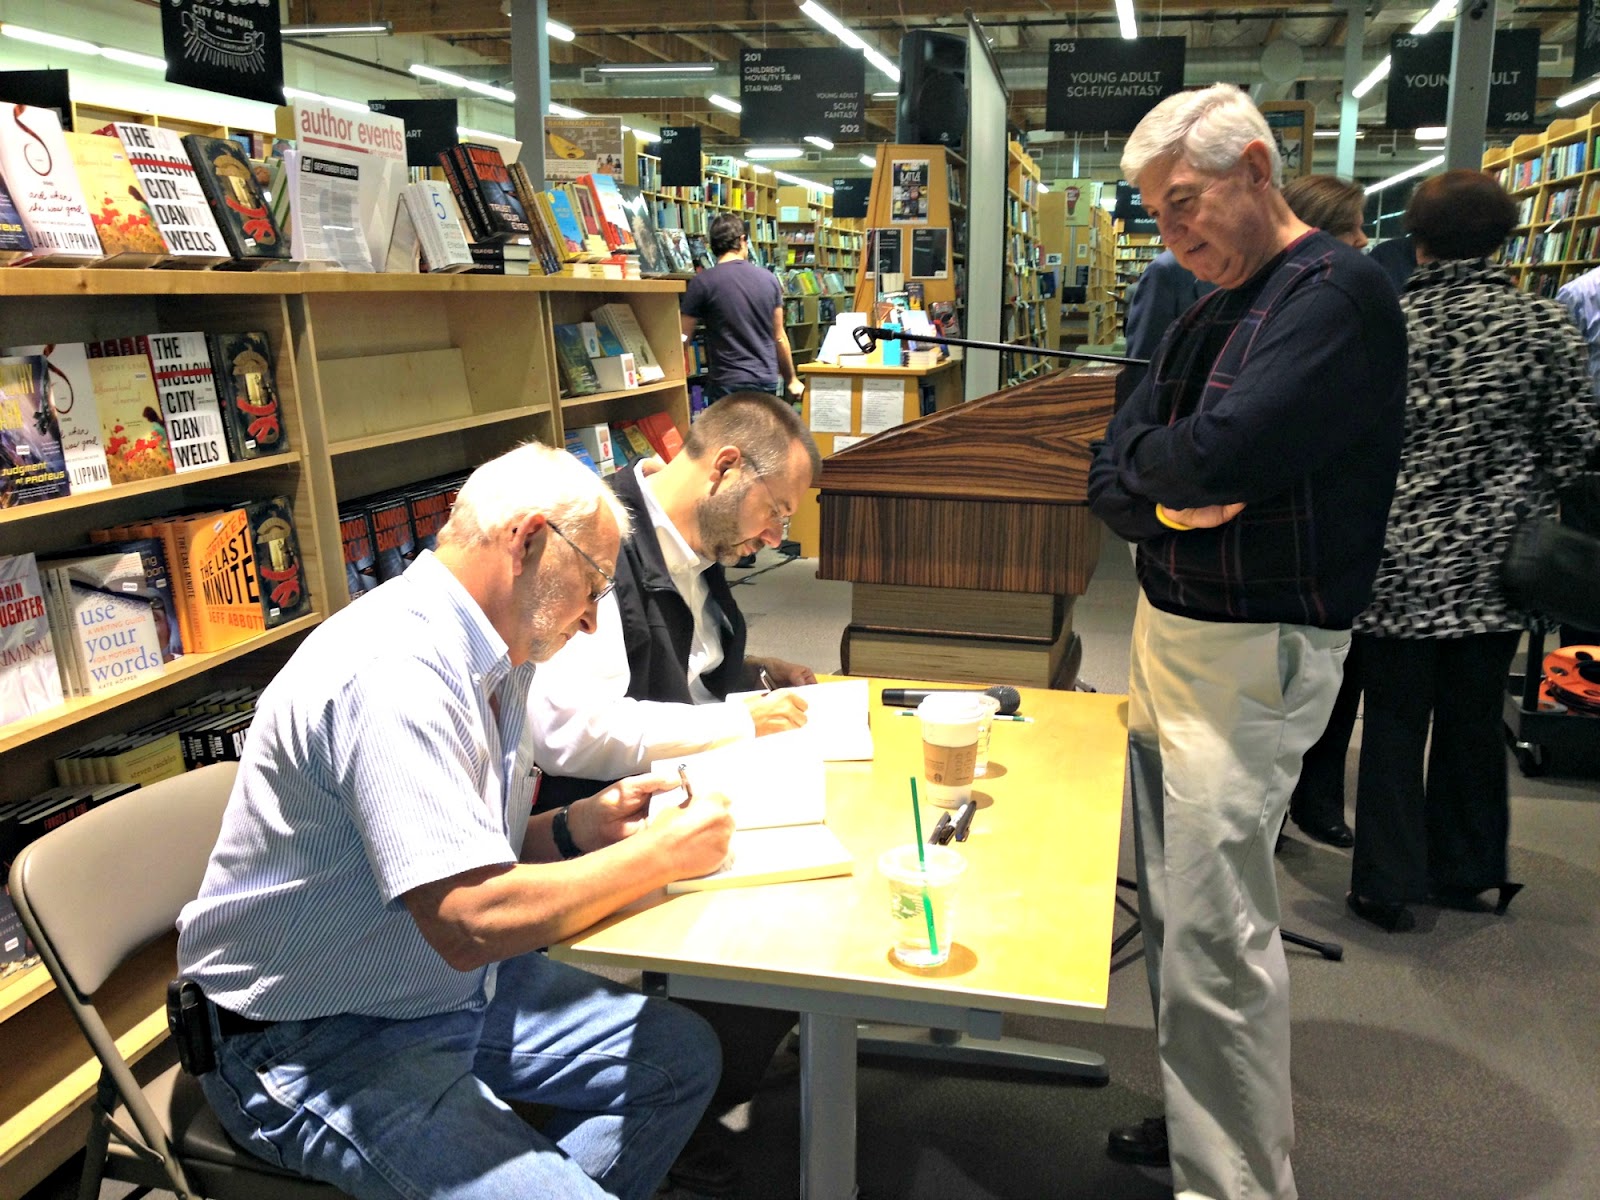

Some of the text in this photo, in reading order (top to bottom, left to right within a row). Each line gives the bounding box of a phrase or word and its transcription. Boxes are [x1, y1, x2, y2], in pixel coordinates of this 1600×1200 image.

[192, 4, 254, 29] CITY OF BOOKS
[744, 53, 761, 62] 201
[1054, 43, 1076, 52] 203
[744, 66, 786, 74] CHILDREN'S
[1070, 71, 1161, 84] YOUNG ADULT
[1404, 71, 1520, 88] YOUN ULT
[1066, 85, 1163, 98] SCI-FI/FANTASY
[824, 111, 858, 119] FANTASY
[1504, 112, 1529, 122] 206
[120, 125, 156, 149] THE
[301, 108, 403, 152] author events
[406, 130, 422, 138] ART
[840, 124, 860, 133] 202
[132, 152, 194, 178] HOLLOW
[340, 166, 358, 177] EVENTS
[144, 177, 180, 200] CITY
[155, 204, 190, 226] DAN
[432, 193, 447, 220] 5
[489, 203, 513, 213] TRUST
[502, 213, 520, 223] YOUR
[511, 222, 530, 231] EYES
[29, 231, 61, 249] LAURA
[60, 232, 100, 250] LIPPMAN
[164, 230, 217, 252] WELLS
[153, 337, 182, 360] THE
[160, 361, 212, 387] HOLLOW
[166, 389, 196, 414] CITY
[172, 417, 200, 441] DAN
[175, 440, 220, 467] WELLS
[0, 462, 47, 477] Judgment
[73, 464, 108, 486] LIPPMAN
[340, 518, 367, 540] WOOD
[200, 524, 249, 580] THE LAST
[343, 537, 371, 563] RCLAY
[183, 571, 196, 599] MINUTE
[202, 555, 260, 606] MINUTE
[0, 595, 44, 628] UGHTER
[80, 604, 116, 626] use
[208, 611, 264, 631] JEFF ABBOTT
[94, 622, 123, 633] WRITING
[0, 637, 52, 667] IMINAL
[85, 628, 136, 663] your
[90, 646, 159, 682] words
